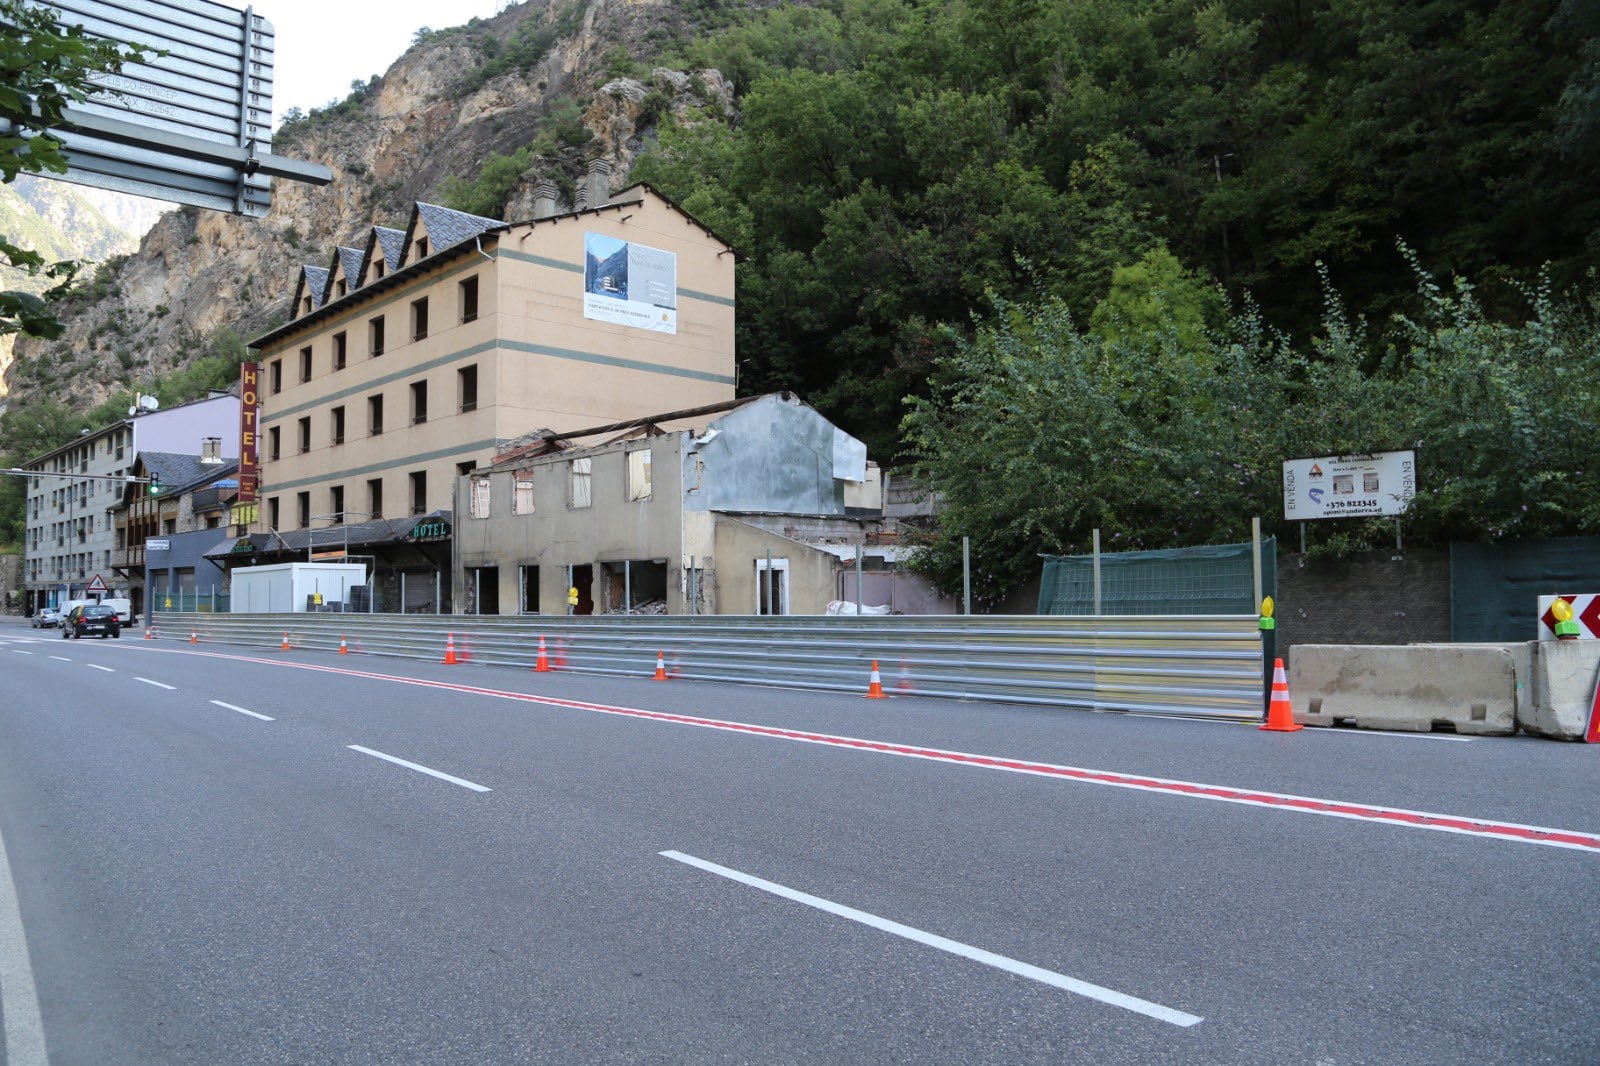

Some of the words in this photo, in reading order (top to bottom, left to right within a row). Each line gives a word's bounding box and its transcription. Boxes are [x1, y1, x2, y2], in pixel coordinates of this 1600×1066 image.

[243, 371, 256, 465] HOTEL
[1402, 461, 1412, 473] EN
[1286, 469, 1296, 496] VENDA
[1287, 499, 1296, 510] EN
[1326, 501, 1345, 509] +376
[1346, 499, 1377, 508] 822345
[413, 522, 447, 537] HOTEL
